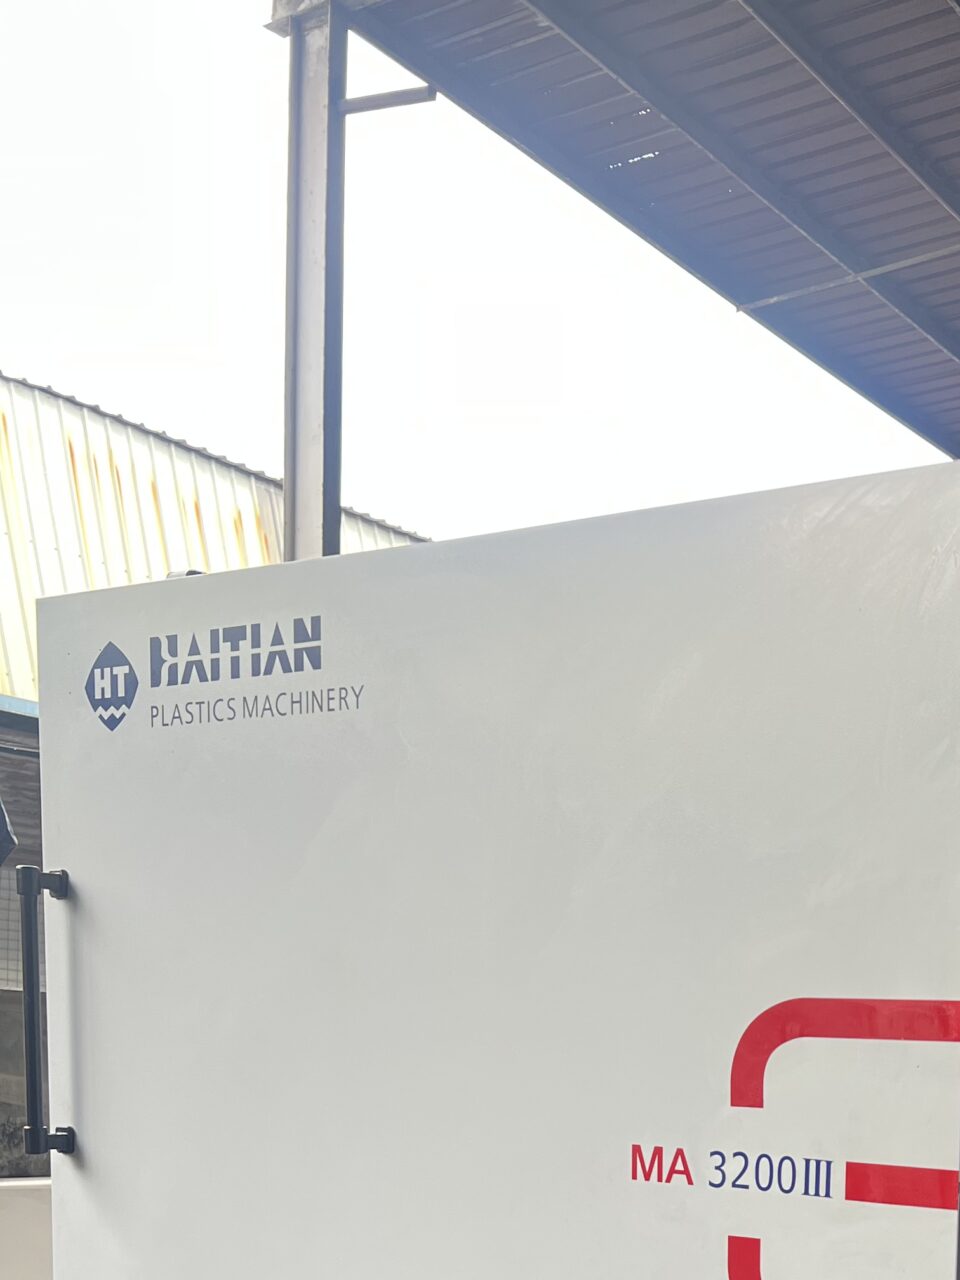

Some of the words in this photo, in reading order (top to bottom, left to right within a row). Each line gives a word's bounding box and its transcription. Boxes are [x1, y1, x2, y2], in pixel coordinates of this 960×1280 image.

[150, 615, 322, 688] HAITIAN
[94, 665, 130, 699] HT
[150, 697, 236, 728] PLASTICS
[242, 685, 365, 719] MACHINERY
[631, 1144, 694, 1186] MA
